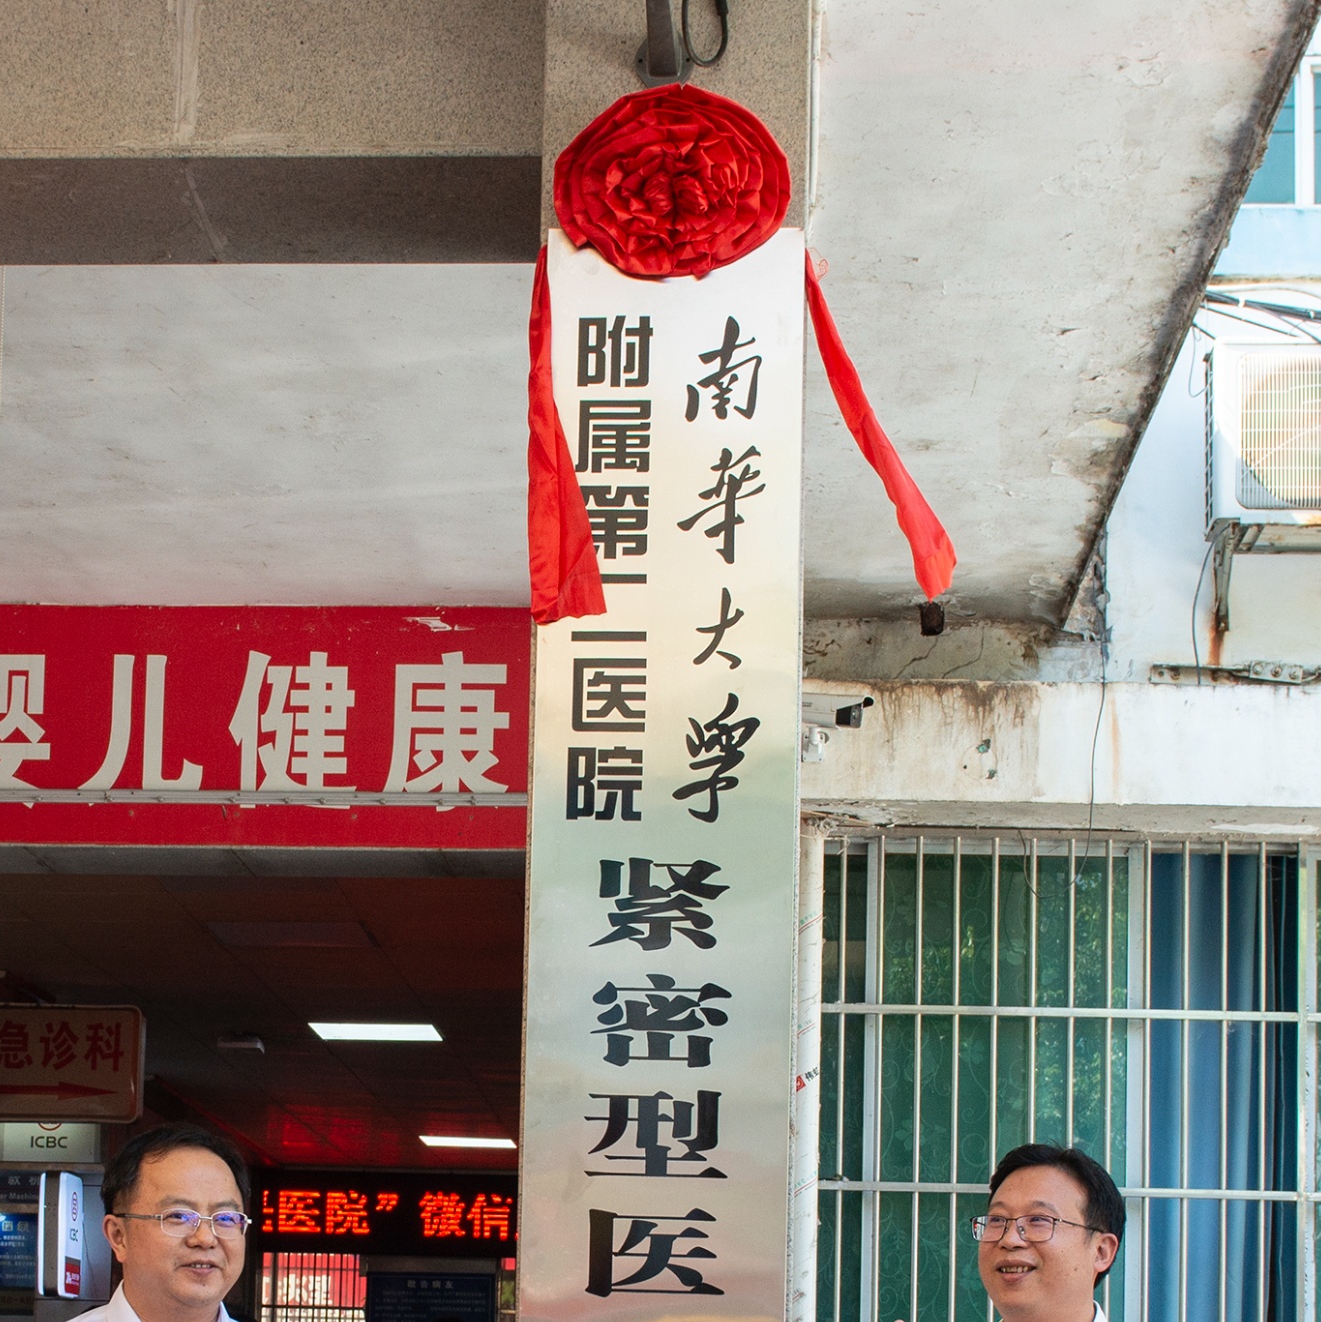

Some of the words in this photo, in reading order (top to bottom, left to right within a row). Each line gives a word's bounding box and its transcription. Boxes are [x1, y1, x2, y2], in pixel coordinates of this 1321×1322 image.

[565, 315, 653, 822] 附属第二医院
[30, 1136, 68, 1149] ICBC
[406, 1279, 455, 1290] 敬告病友
